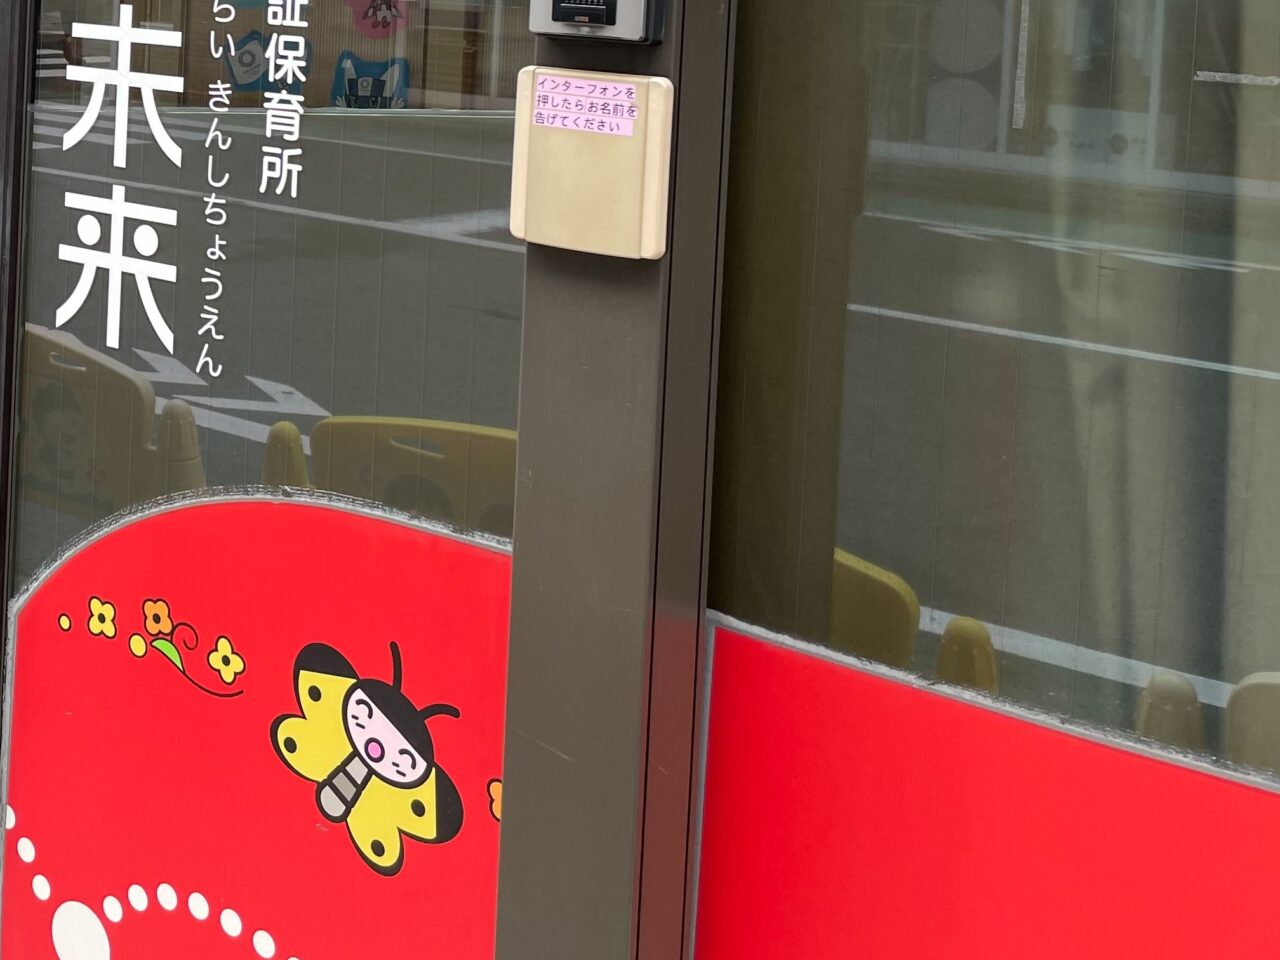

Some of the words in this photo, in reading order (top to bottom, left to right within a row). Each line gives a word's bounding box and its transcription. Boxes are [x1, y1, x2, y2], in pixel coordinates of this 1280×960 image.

[537, 78, 635, 99] インターフォンを
[536, 94, 637, 118] 押したらお名前を
[534, 112, 620, 133] 告げてください
[195, 78, 234, 378] きんしちょうえん
